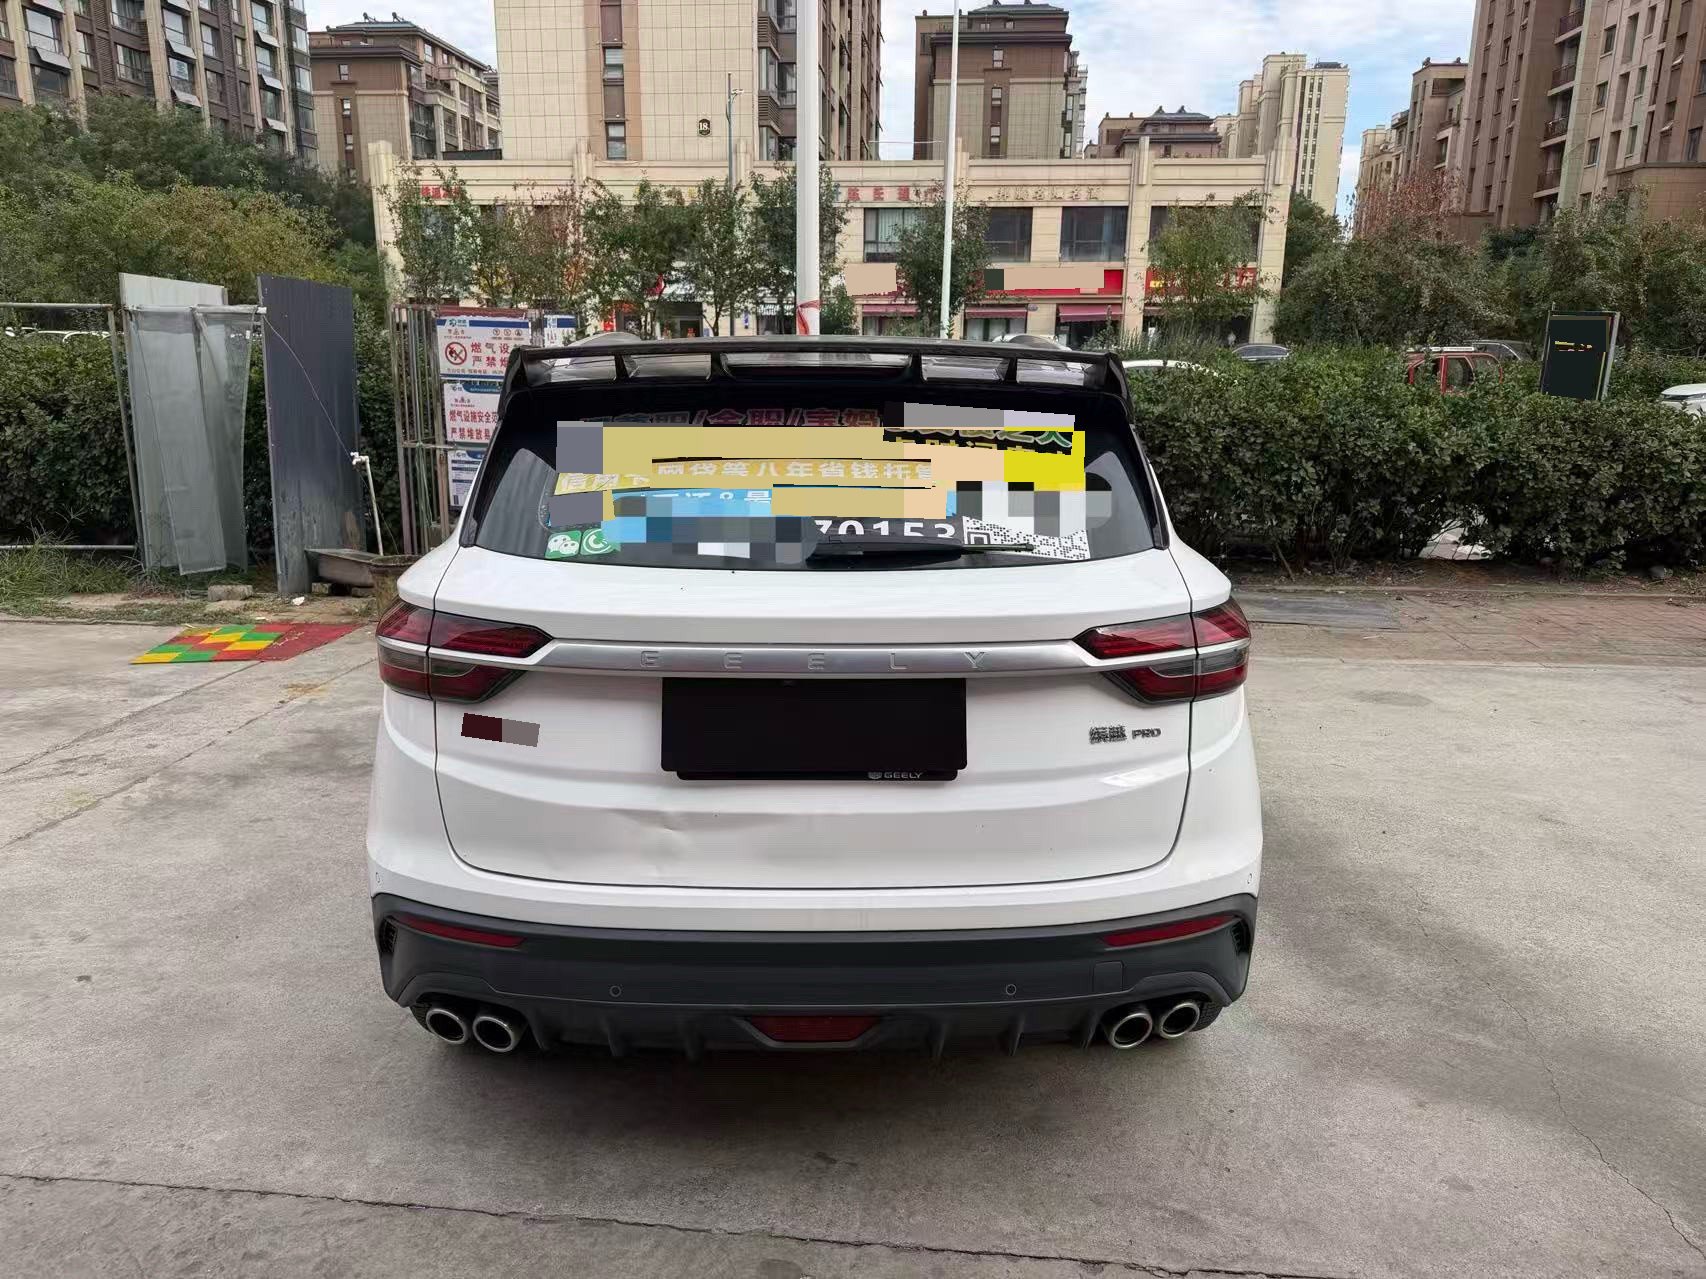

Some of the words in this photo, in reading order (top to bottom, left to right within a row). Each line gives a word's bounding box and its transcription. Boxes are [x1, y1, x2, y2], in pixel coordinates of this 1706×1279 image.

[471, 342, 522, 354] 燃气设
[640, 650, 986, 670] GEELY
[1132, 728, 1161, 739] PRO
[884, 771, 923, 779] GEELY
